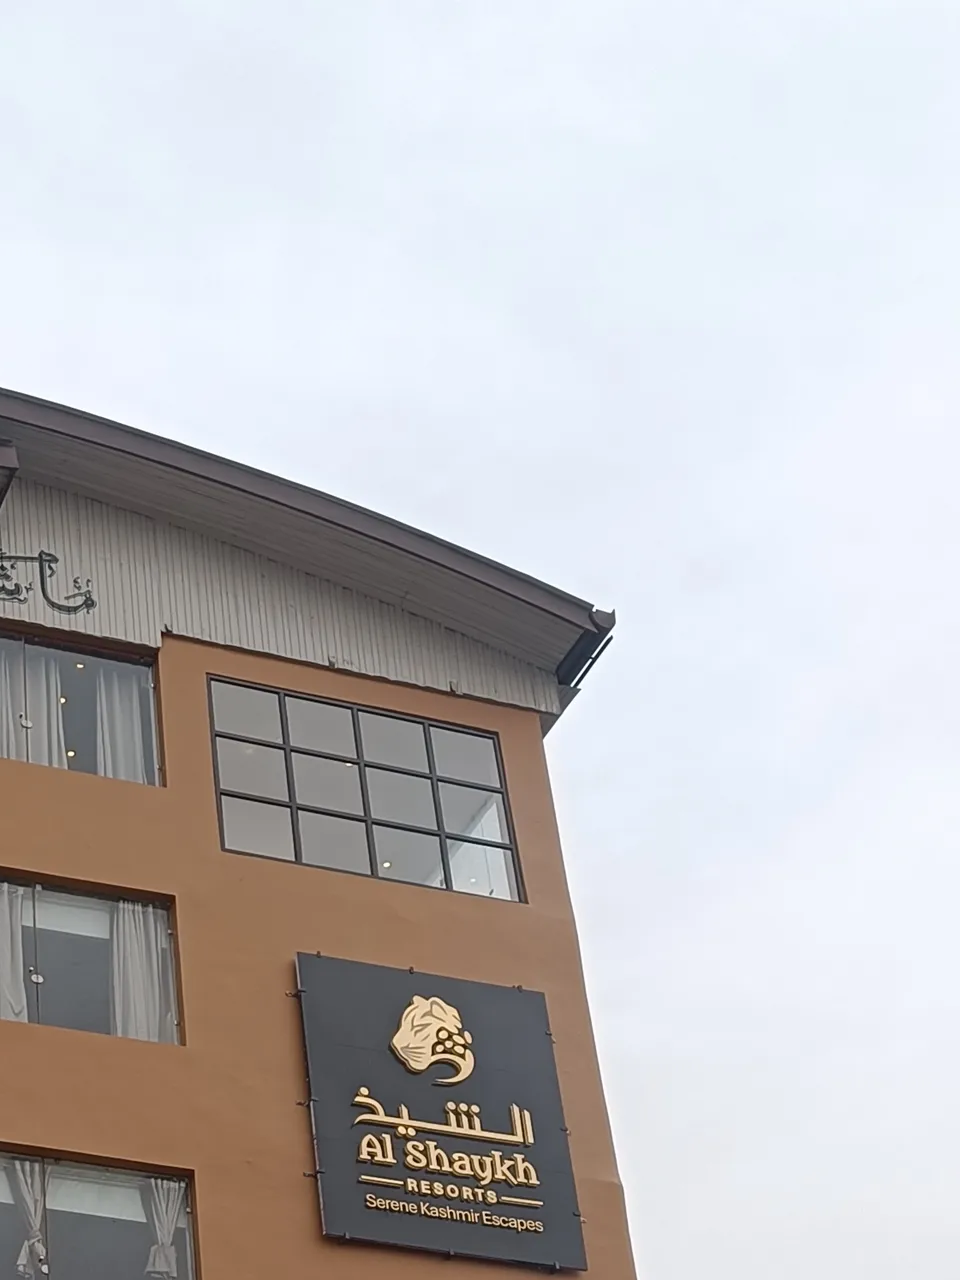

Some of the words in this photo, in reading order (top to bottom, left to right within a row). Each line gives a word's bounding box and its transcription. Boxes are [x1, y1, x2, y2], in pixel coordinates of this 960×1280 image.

[351, 1086, 536, 1147] الشيخ
[357, 1132, 397, 1164] Al
[404, 1139, 541, 1188] Shaykh
[365, 1193, 418, 1216] Serene
[420, 1198, 480, 1225] Kashmir
[482, 1210, 545, 1235] Escapes
[406, 1177, 499, 1204] RESORTS
